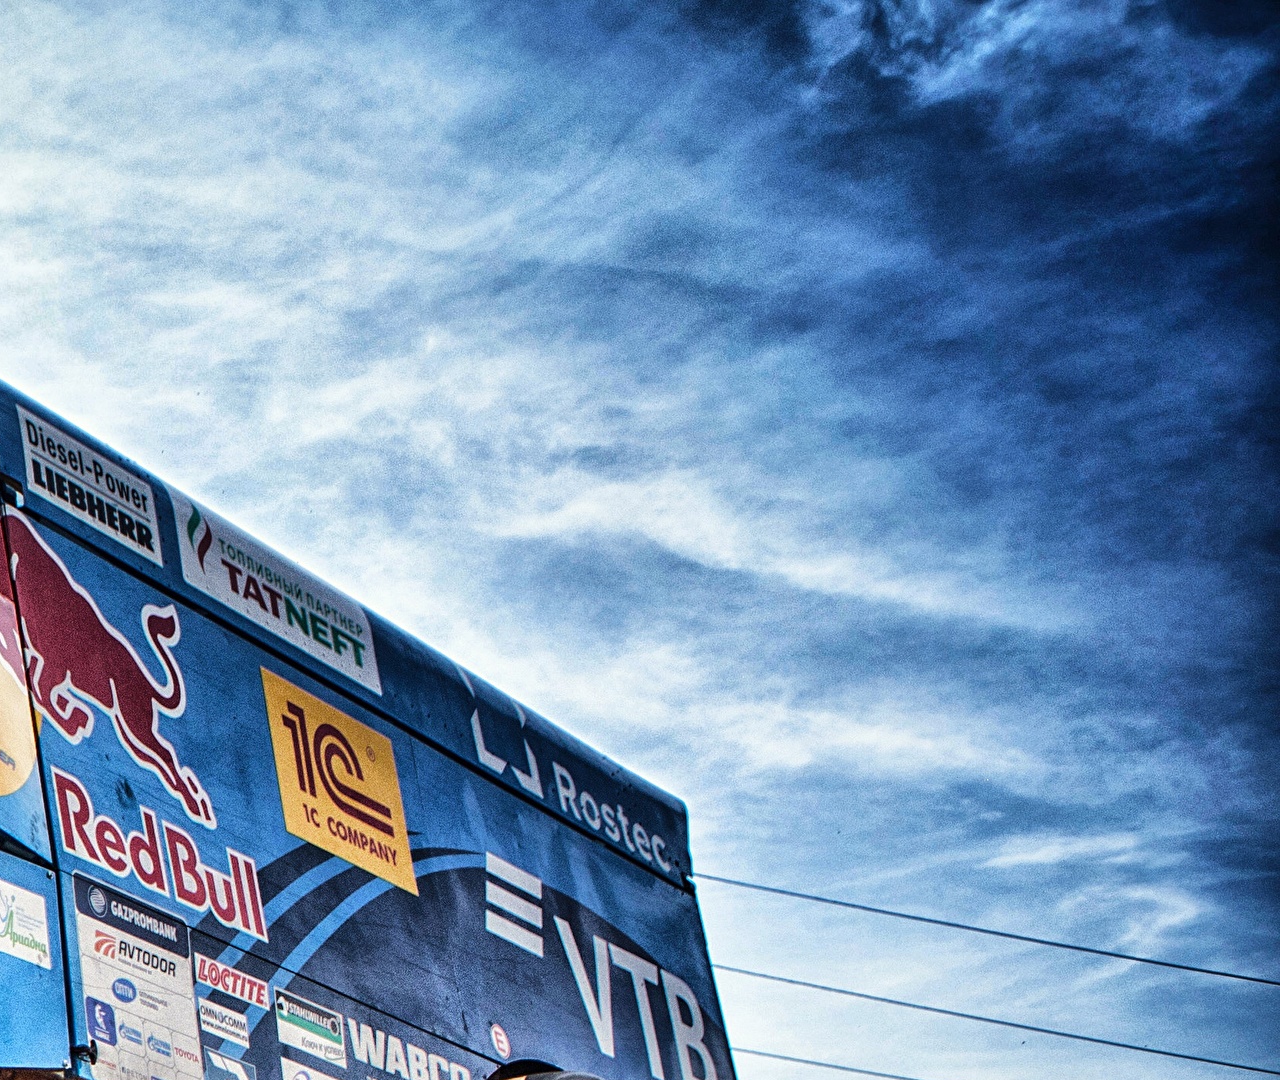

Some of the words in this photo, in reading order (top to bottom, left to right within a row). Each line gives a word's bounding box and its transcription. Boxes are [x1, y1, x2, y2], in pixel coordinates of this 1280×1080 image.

[26, 419, 147, 512] Diesel-Power
[32, 459, 154, 553] LIEBHERR
[218, 538, 302, 600] ТОПЛИВНЫЙ
[307, 591, 362, 636] ПАРТНЕР
[221, 558, 366, 668] TATNEFT
[327, 816, 397, 866] COMPANY
[553, 761, 671, 872] Rostec
[51, 766, 169, 897] Red
[162, 820, 269, 943] Bull
[110, 900, 177, 942] GAZPROMBANK
[119, 940, 176, 977] AVTODOR
[198, 958, 266, 1005] LOCTITE
[289, 1003, 328, 1027] STAHLWILLE
[174, 1047, 200, 1064] TOYOTA
